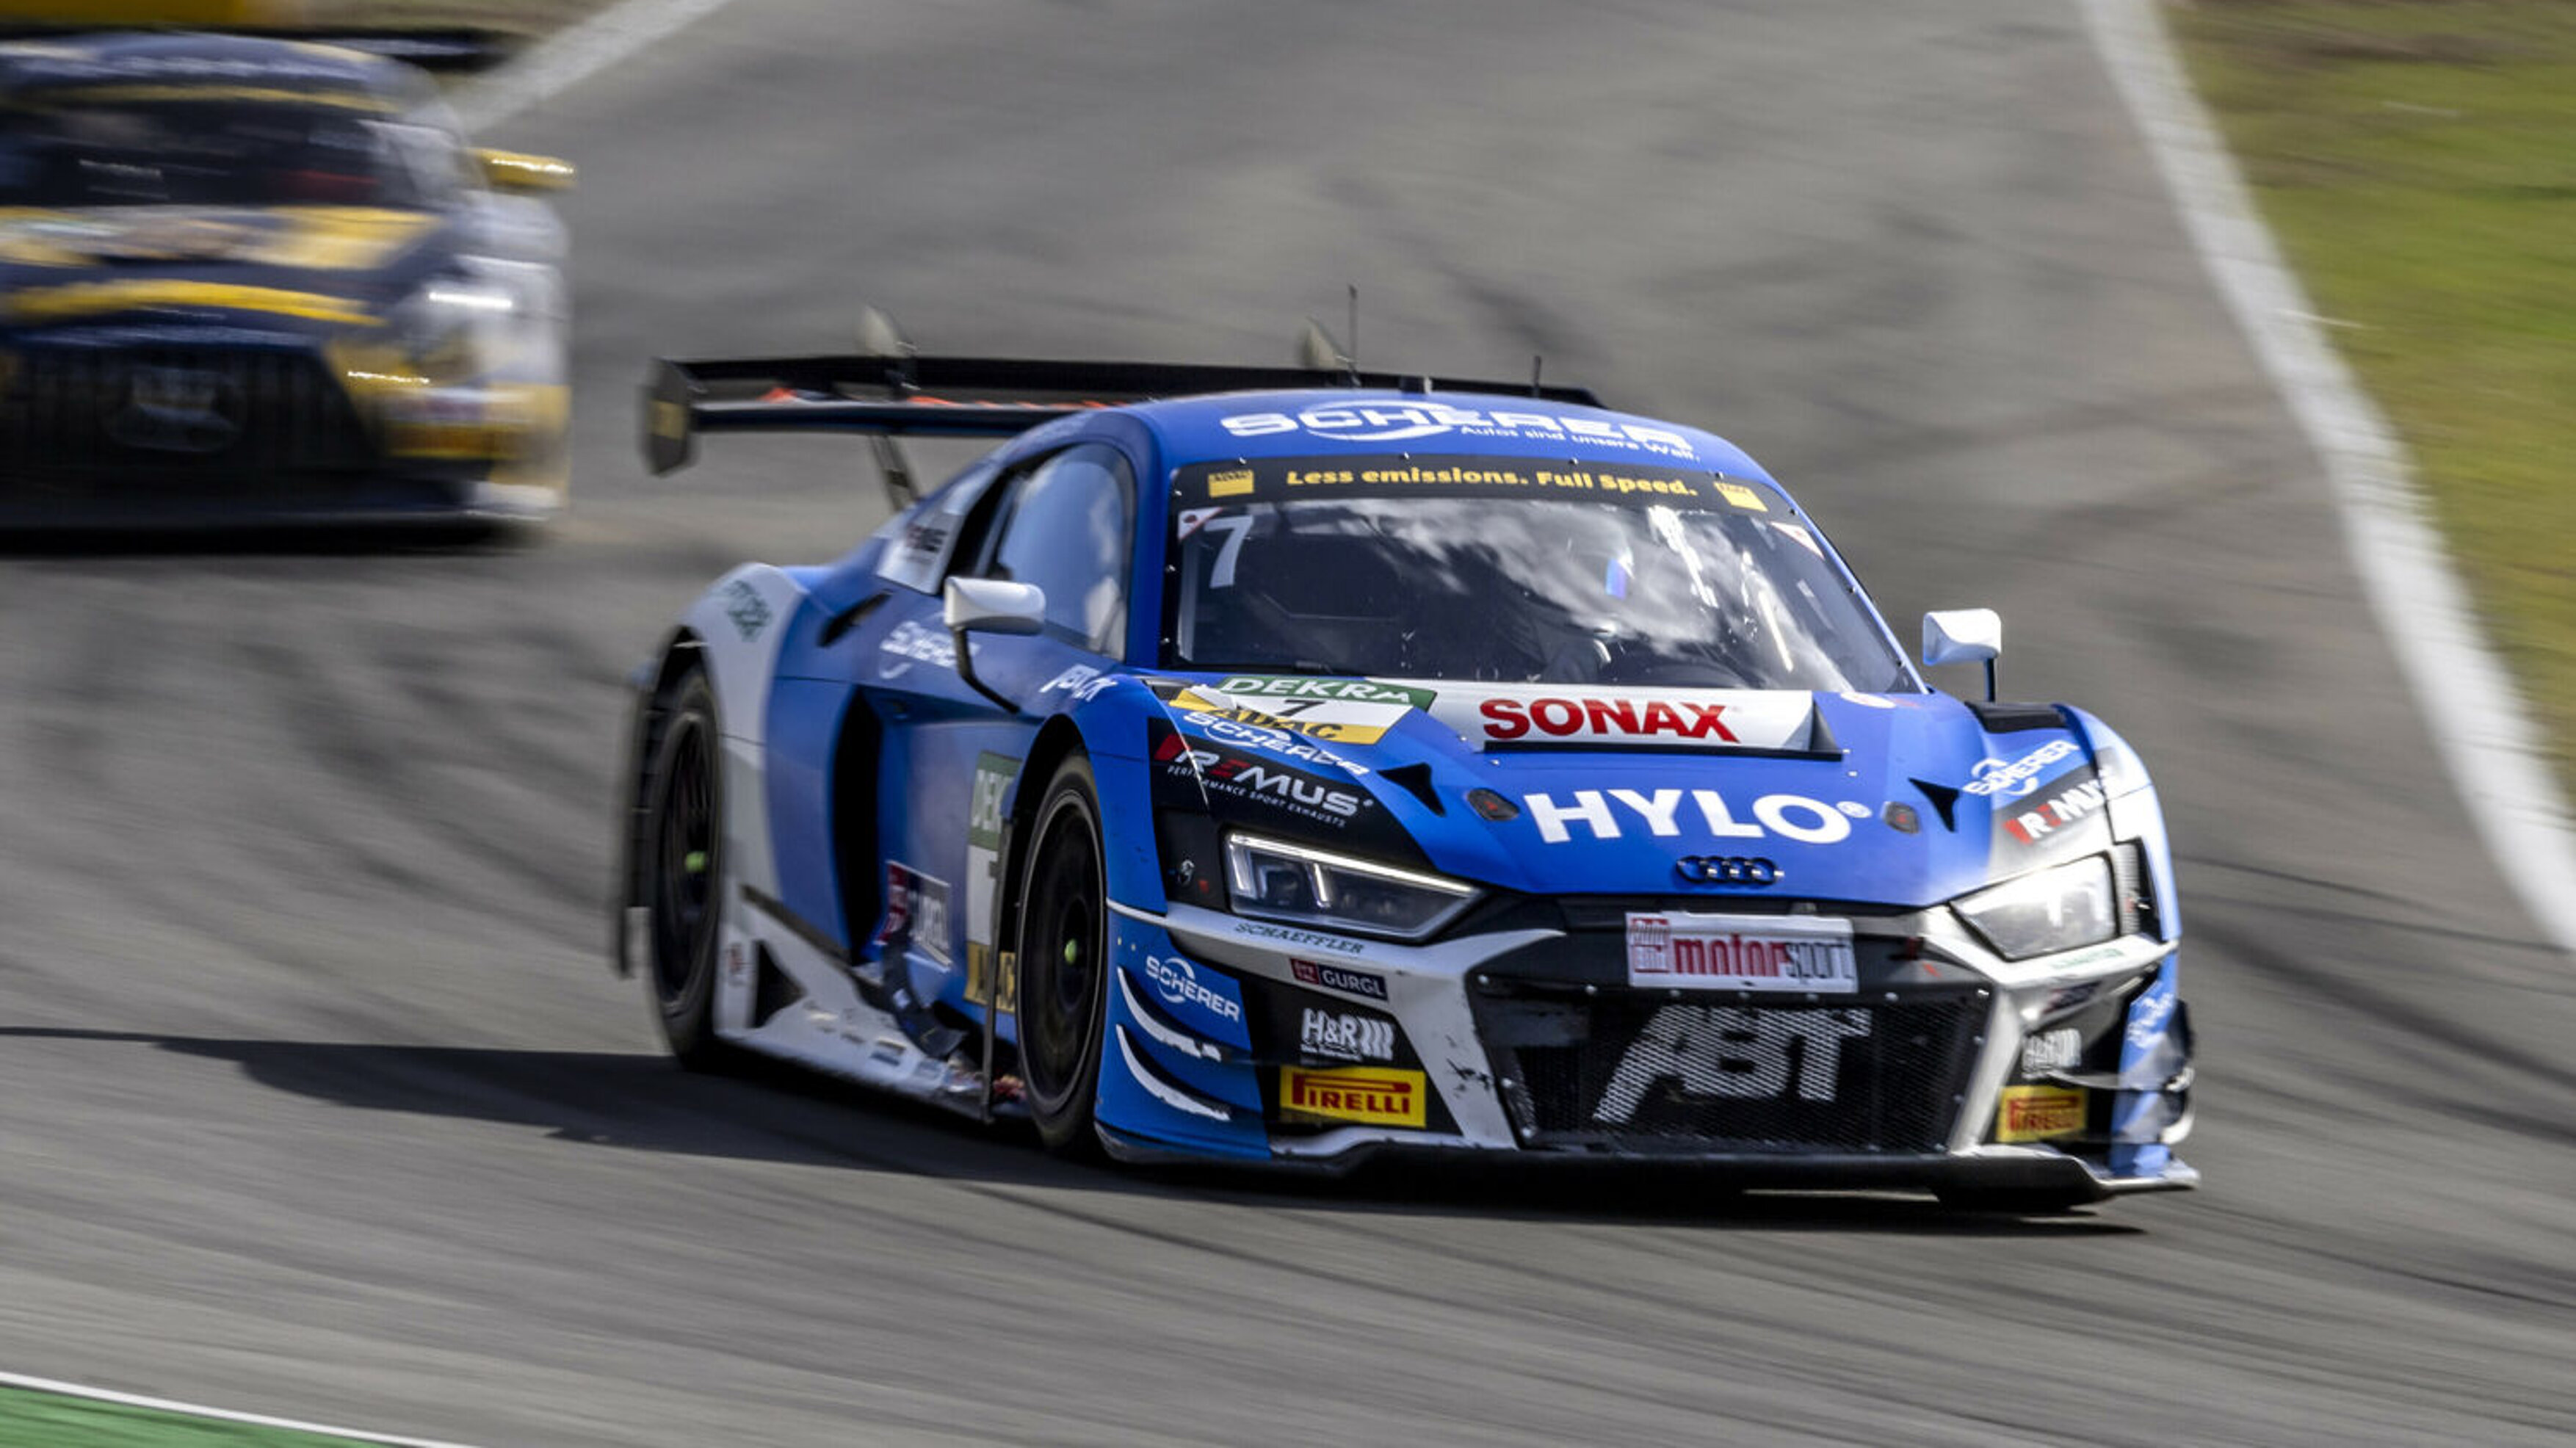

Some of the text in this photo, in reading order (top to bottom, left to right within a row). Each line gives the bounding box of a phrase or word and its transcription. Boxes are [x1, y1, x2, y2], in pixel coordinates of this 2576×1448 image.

[1220, 408, 1693, 452] SCHERER
[1287, 471, 1353, 485] Less
[1361, 466, 1529, 485] emissions.
[1535, 471, 1593, 489] Full
[1598, 474, 1698, 496] Speed.
[1203, 515, 1254, 589] 7
[1222, 678, 1410, 703] DEKRA
[1276, 699, 1328, 717] 7
[1480, 698, 1741, 743] SONAX
[1182, 709, 1371, 777] SCHERER
[1961, 739, 2080, 796] SCHERER
[1524, 788, 1851, 844] HYLO
[1234, 922, 1365, 955] SCHAEFFLER
[1674, 933, 1857, 982] motorsport
[1146, 955, 1242, 1022] SCHERER
[1322, 969, 1386, 997] GURGL
[1301, 1007, 1359, 1051] H&R
[1592, 1004, 1874, 1124] ABT
[1292, 1072, 1412, 1115] PIRELLI
